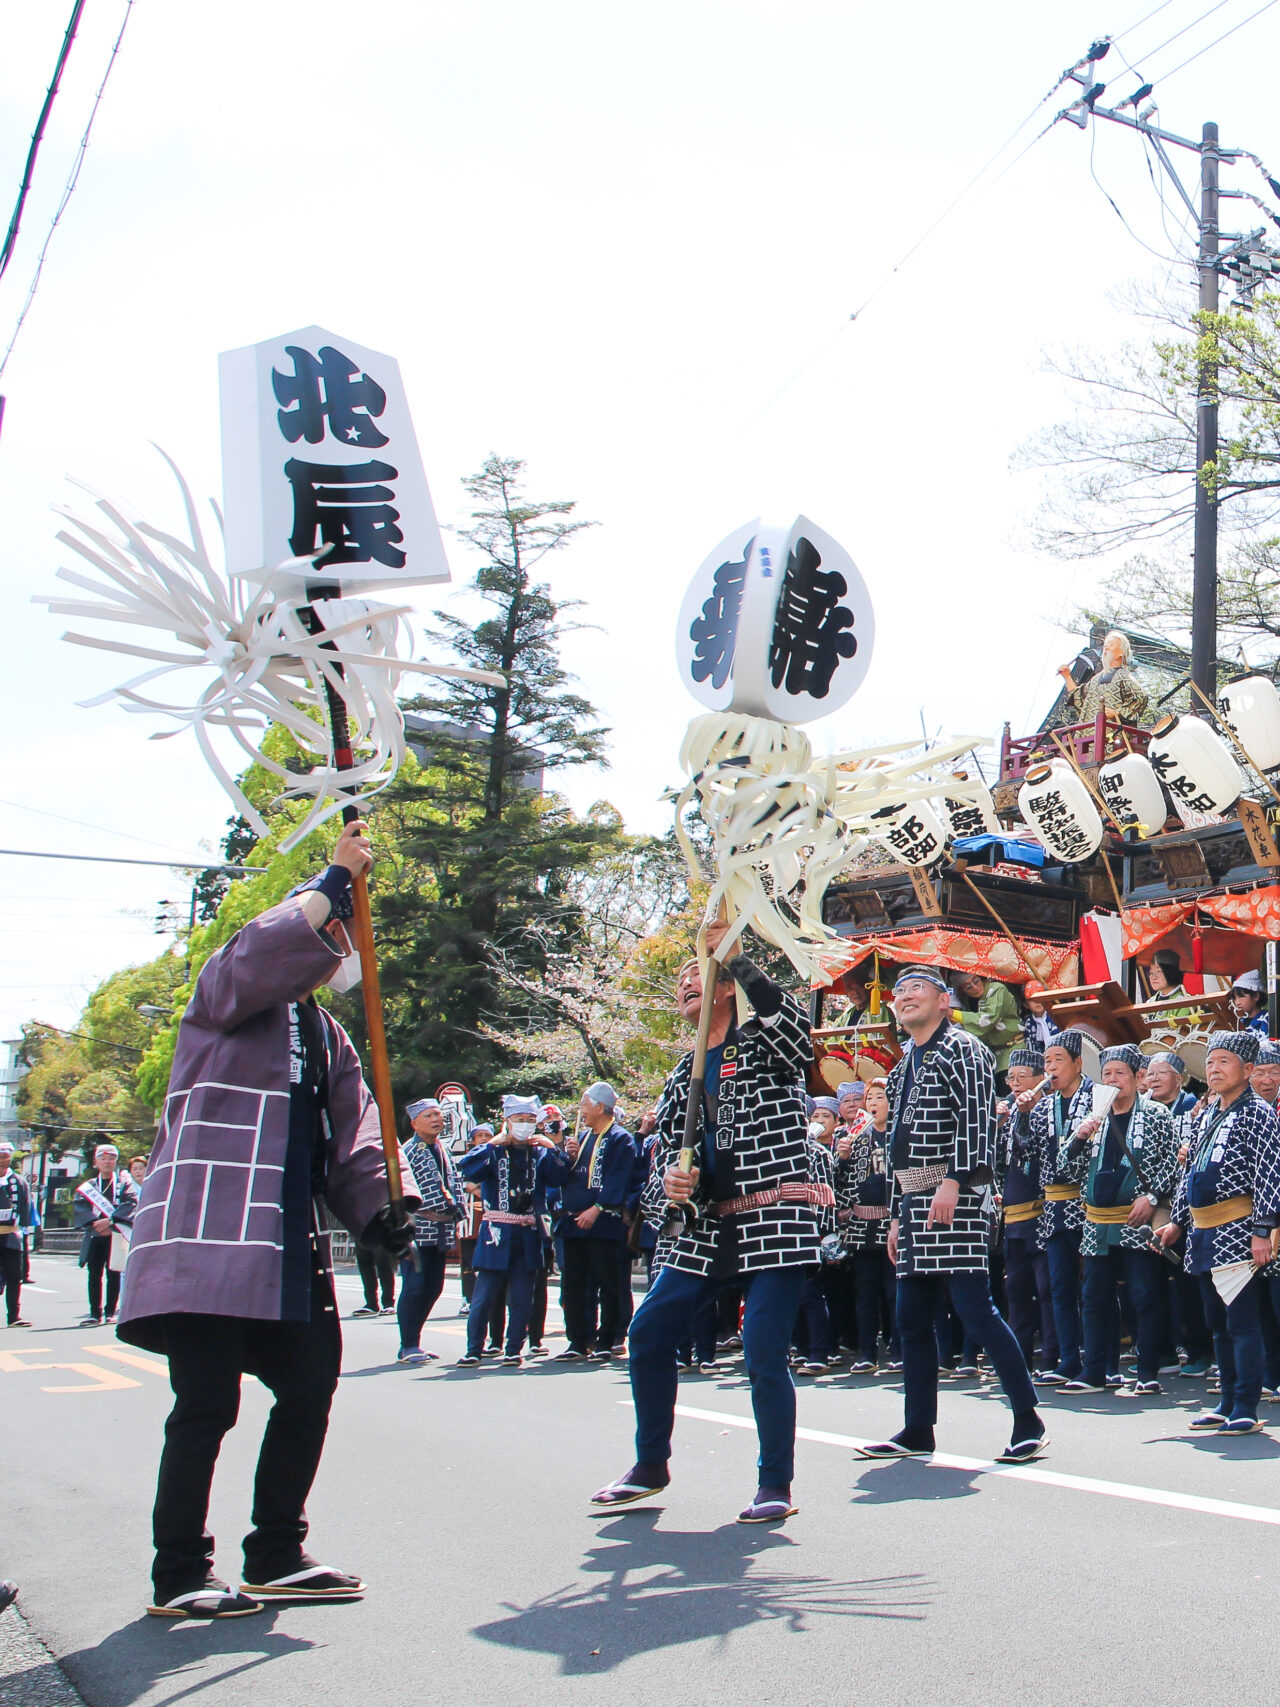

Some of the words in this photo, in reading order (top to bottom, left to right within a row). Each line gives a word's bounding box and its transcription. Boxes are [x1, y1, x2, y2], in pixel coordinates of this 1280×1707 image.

[271, 345, 408, 571] 北辰
[1245, 806, 1271, 859] 木花車
